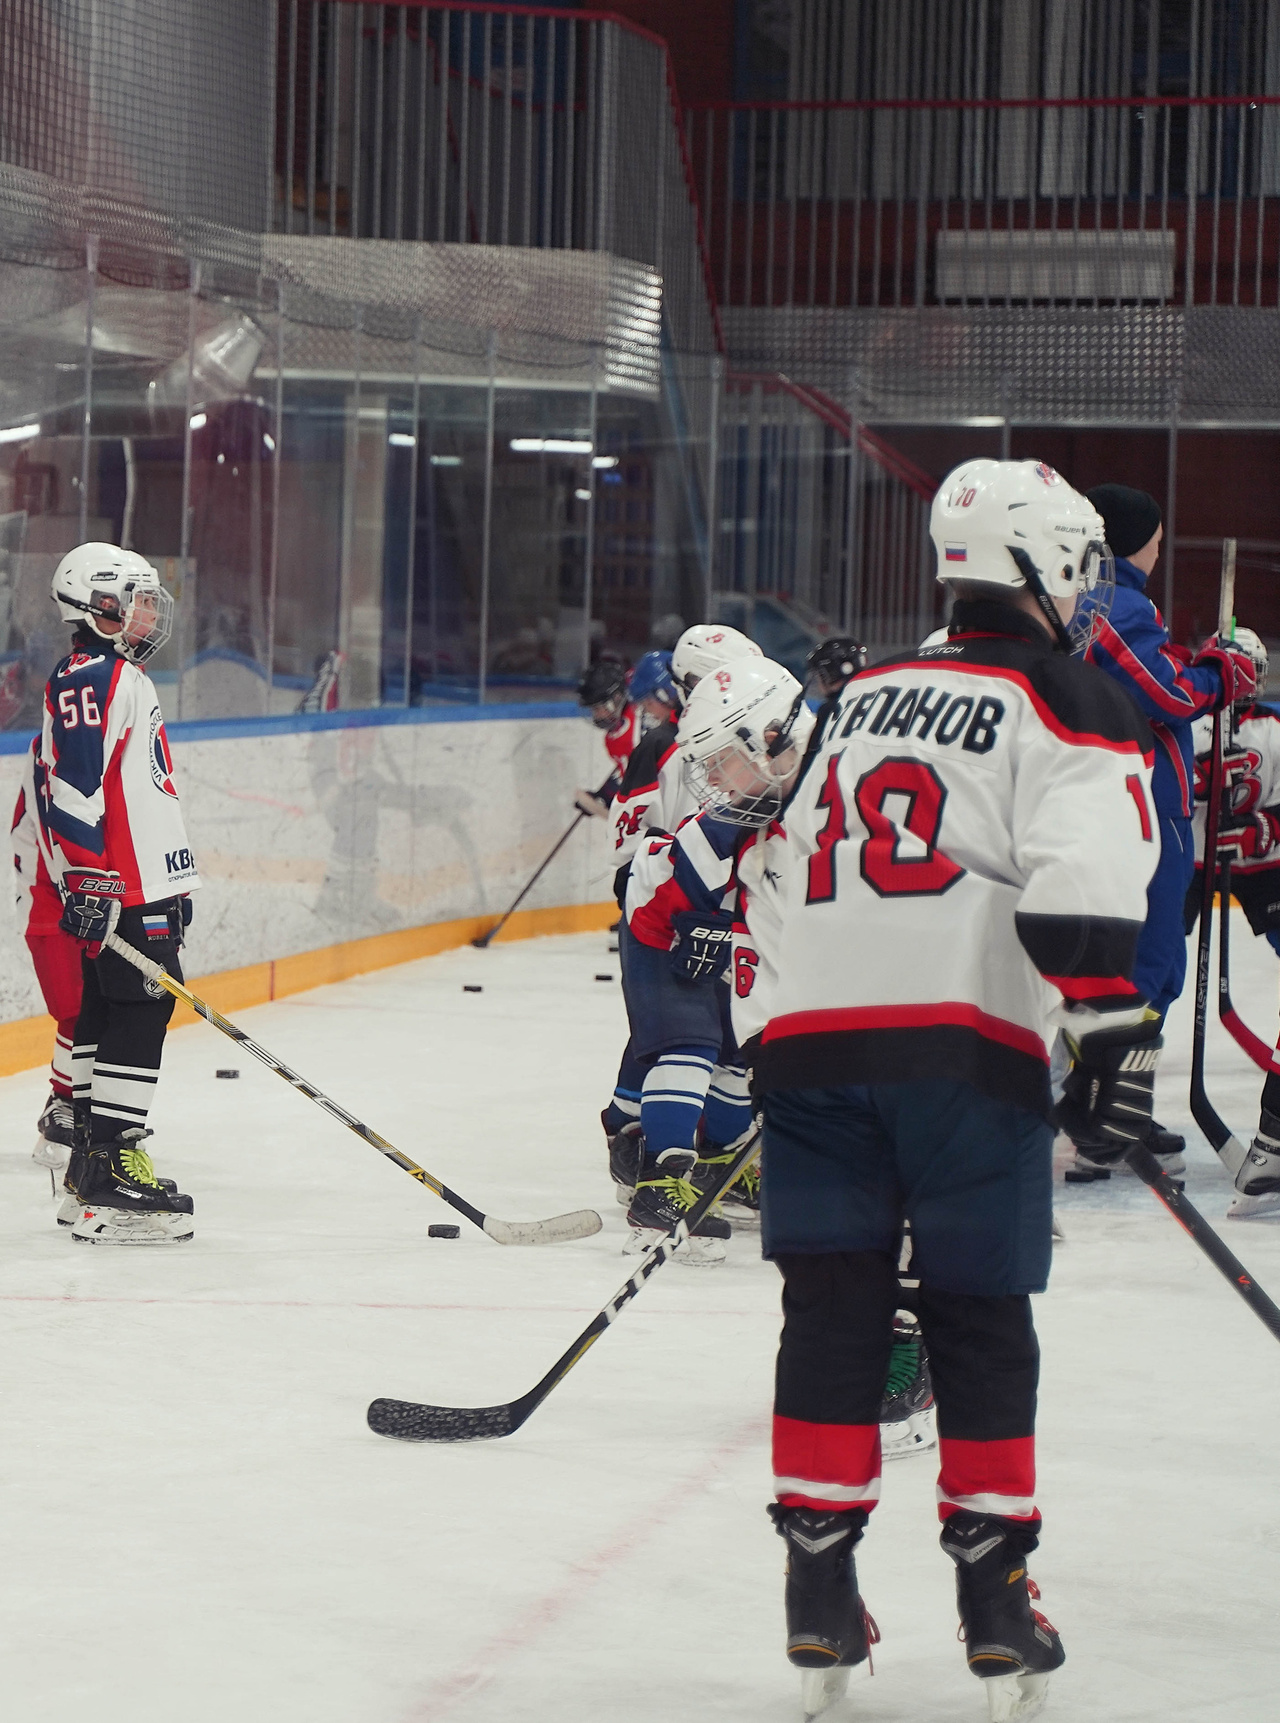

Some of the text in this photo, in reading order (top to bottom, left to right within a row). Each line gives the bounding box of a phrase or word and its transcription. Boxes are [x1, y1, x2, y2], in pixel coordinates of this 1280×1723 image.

[918, 645, 965, 657] LUTCH
[58, 685, 103, 730] 56
[804, 746, 968, 907] 10
[734, 945, 760, 999] 6
[604, 1218, 690, 1325] CCM
